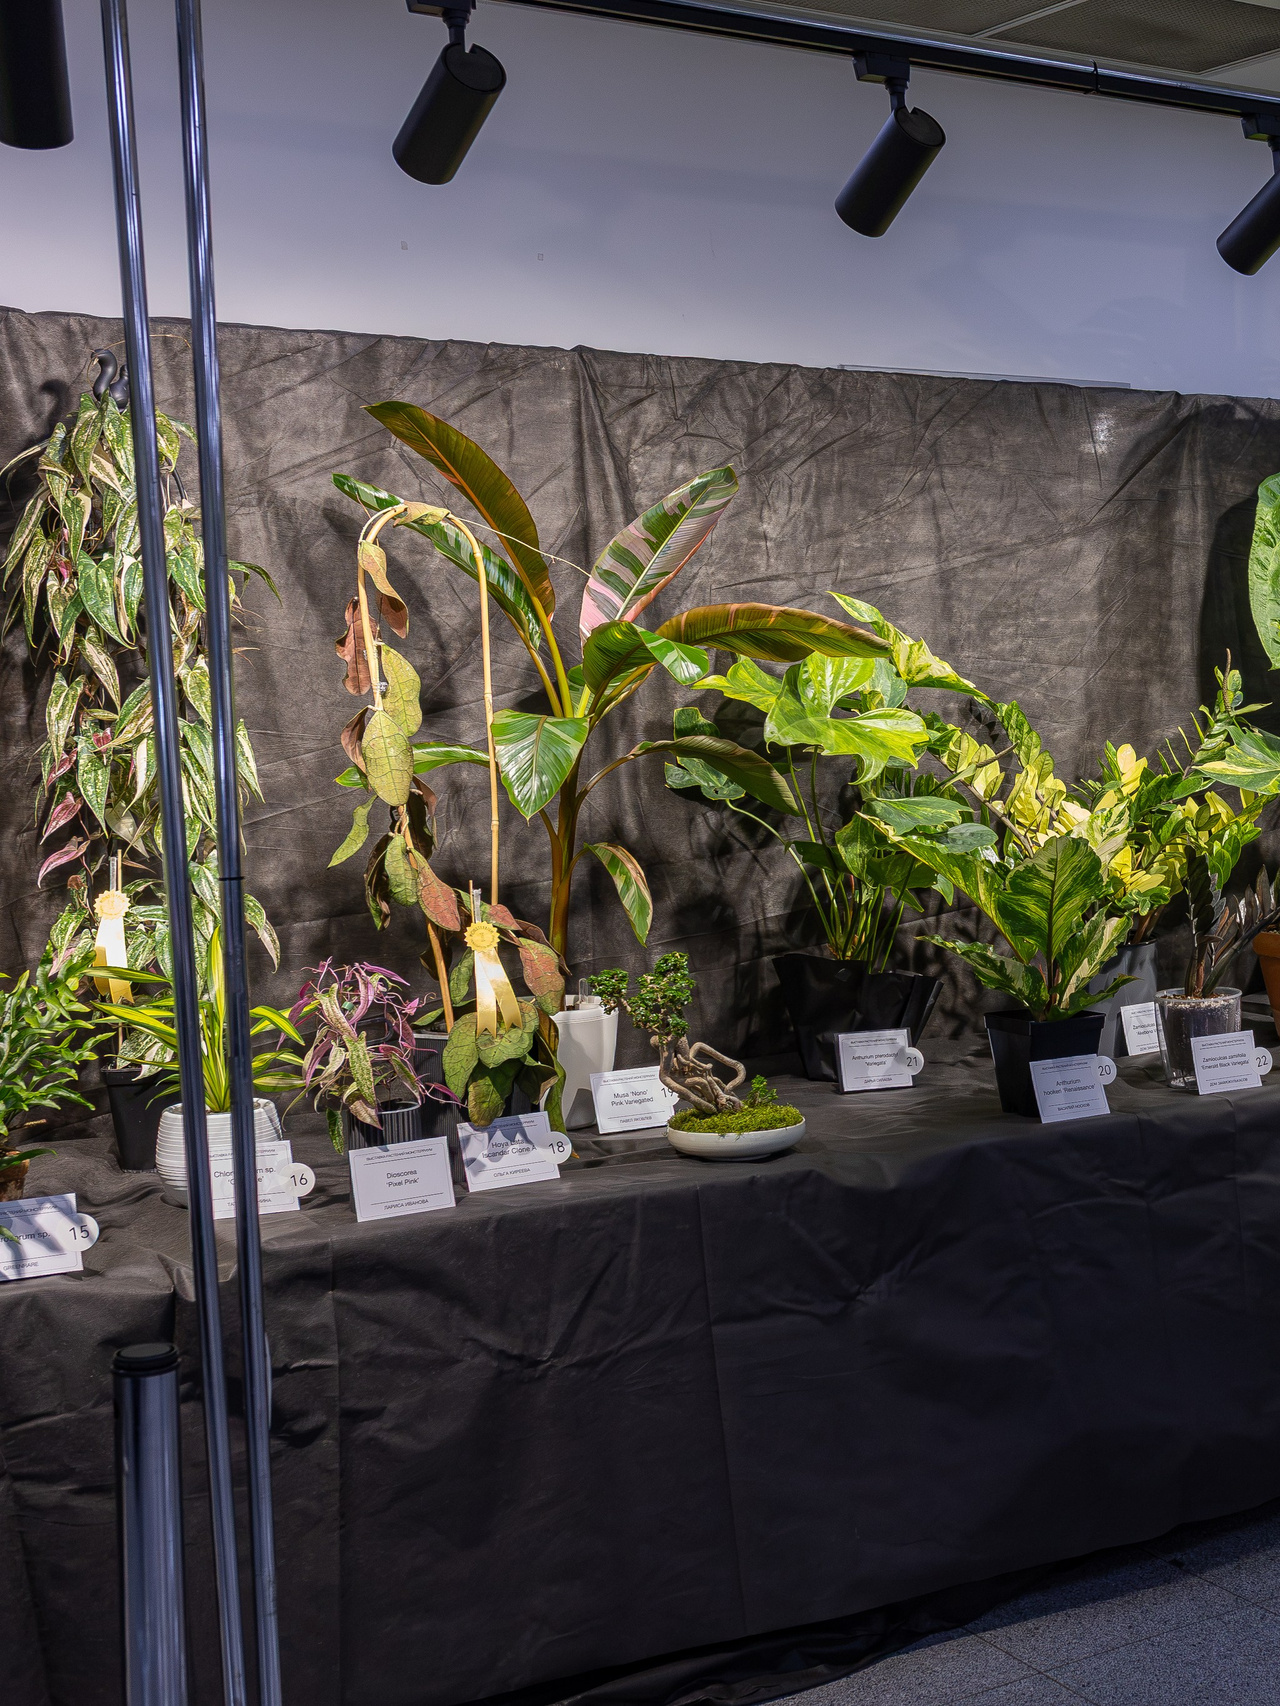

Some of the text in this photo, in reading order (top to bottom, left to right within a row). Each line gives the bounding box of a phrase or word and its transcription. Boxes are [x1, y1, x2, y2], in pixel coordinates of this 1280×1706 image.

[907, 1056, 918, 1067] 21
[1256, 1055, 1268, 1068] 22
[1098, 1065, 1112, 1076] 20
[661, 1087, 673, 1098] 19
[624, 1097, 654, 1105] Variegated
[492, 1141, 509, 1149] Hoya
[549, 1141, 565, 1154] 18
[482, 1149, 510, 1159] Iscandar
[512, 1146, 530, 1154] Clone
[214, 1168, 263, 1178] Chlorm
[387, 1170, 417, 1179] Dioscorea
[290, 1173, 308, 1187] 16
[405, 1199, 429, 1207] ИВАНОВА
[37, 1231, 51, 1240] sp.
[69, 1224, 90, 1241] 15
[3, 1262, 39, 1271] GREENRARE
